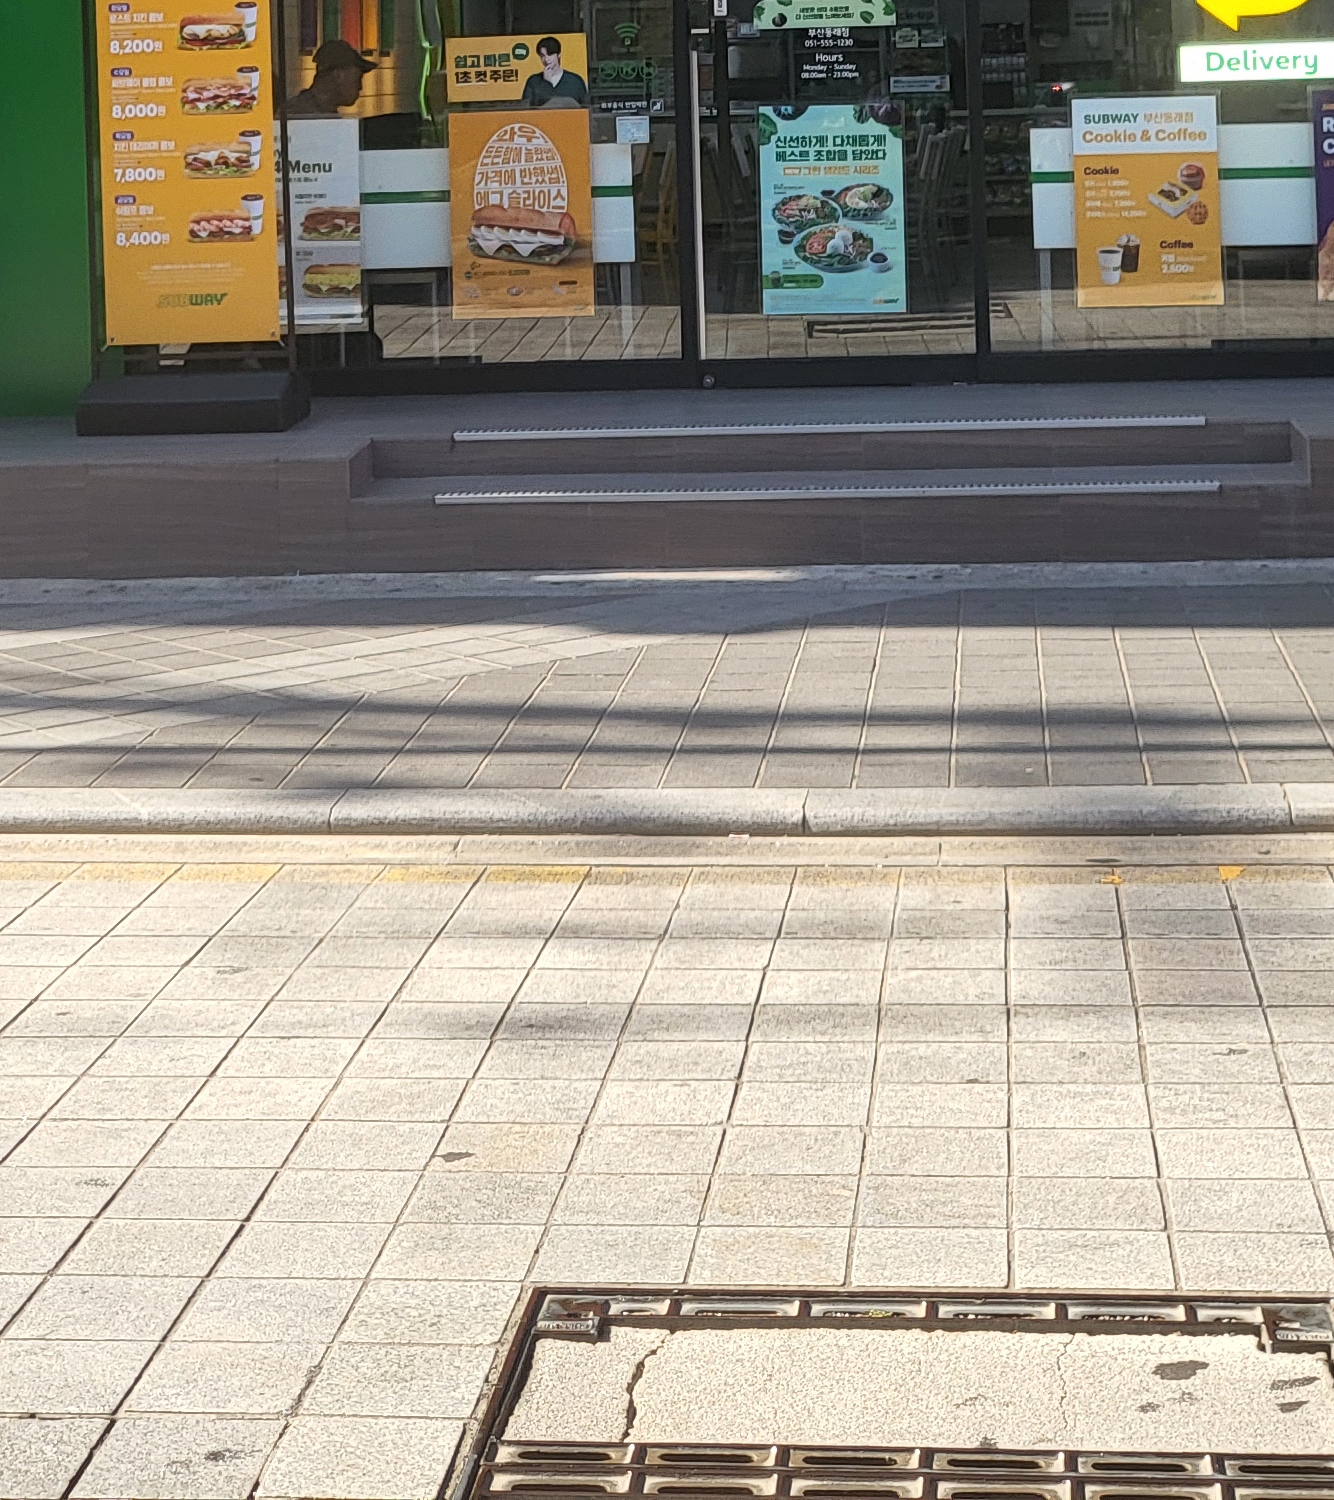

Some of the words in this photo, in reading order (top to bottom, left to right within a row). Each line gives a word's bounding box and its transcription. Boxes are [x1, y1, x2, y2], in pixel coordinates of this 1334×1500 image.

[804, 38, 853, 48] 051-555-1230
[454, 55, 480, 69] 쉽고
[815, 52, 844, 62] Hours
[1206, 49, 1318, 75] Delivery
[833, 63, 857, 71] Sunday
[1083, 112, 1140, 125] SUBWAY
[774, 134, 829, 149] 신선하게!
[1082, 129, 1137, 143] Cookie
[1140, 129, 1152, 142] &
[1154, 127, 1208, 142] Coffee
[775, 150, 811, 163] 베스트
[475, 168, 516, 187] 가격에
[1083, 166, 1120, 176] Cookie
[1159, 240, 1194, 250] Coffee
